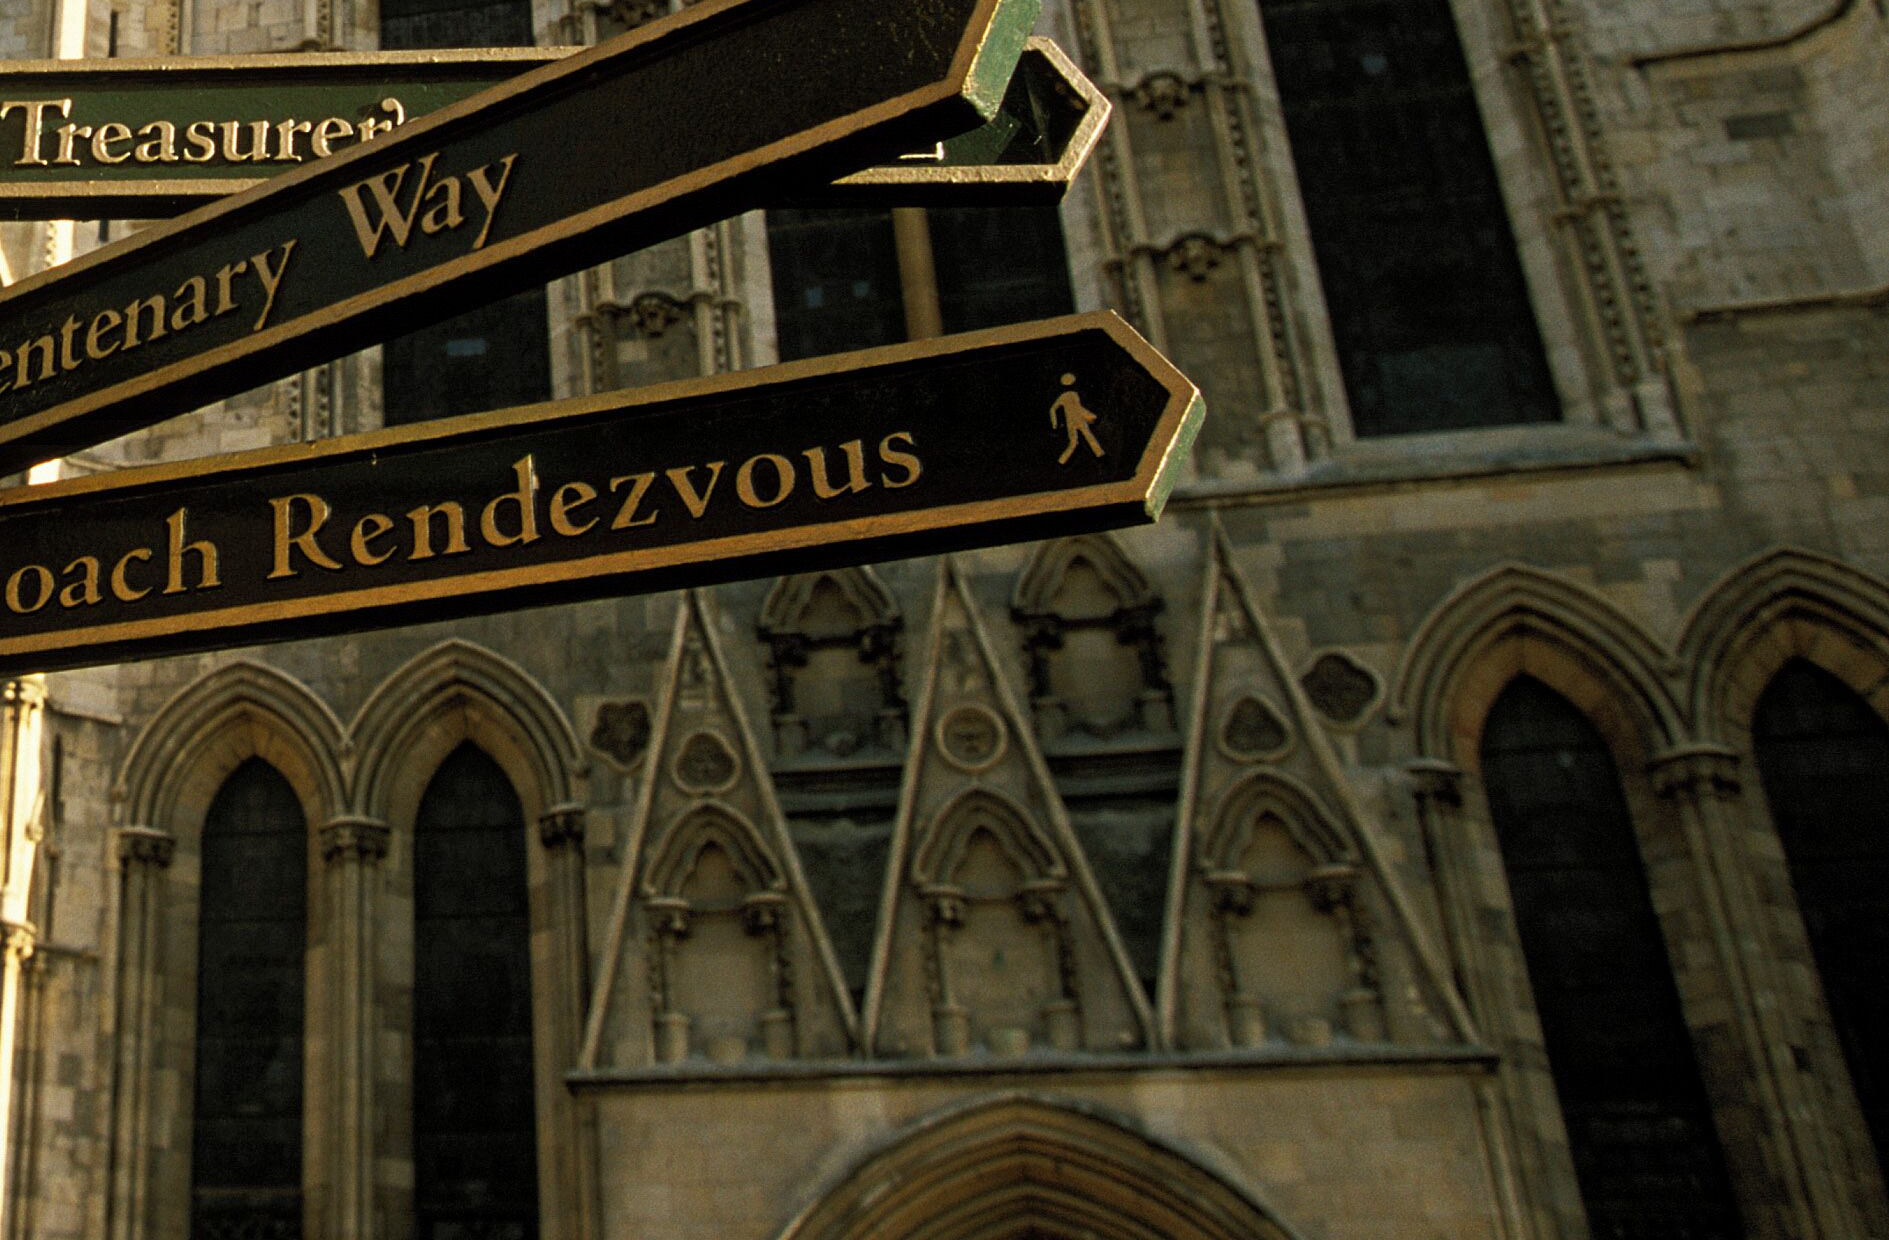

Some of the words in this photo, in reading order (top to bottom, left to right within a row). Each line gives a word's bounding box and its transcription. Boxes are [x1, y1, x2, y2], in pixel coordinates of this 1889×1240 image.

[0, 97, 419, 166] Treasurer'
[338, 151, 518, 260] Way
[265, 428, 924, 581] Rendezvous
